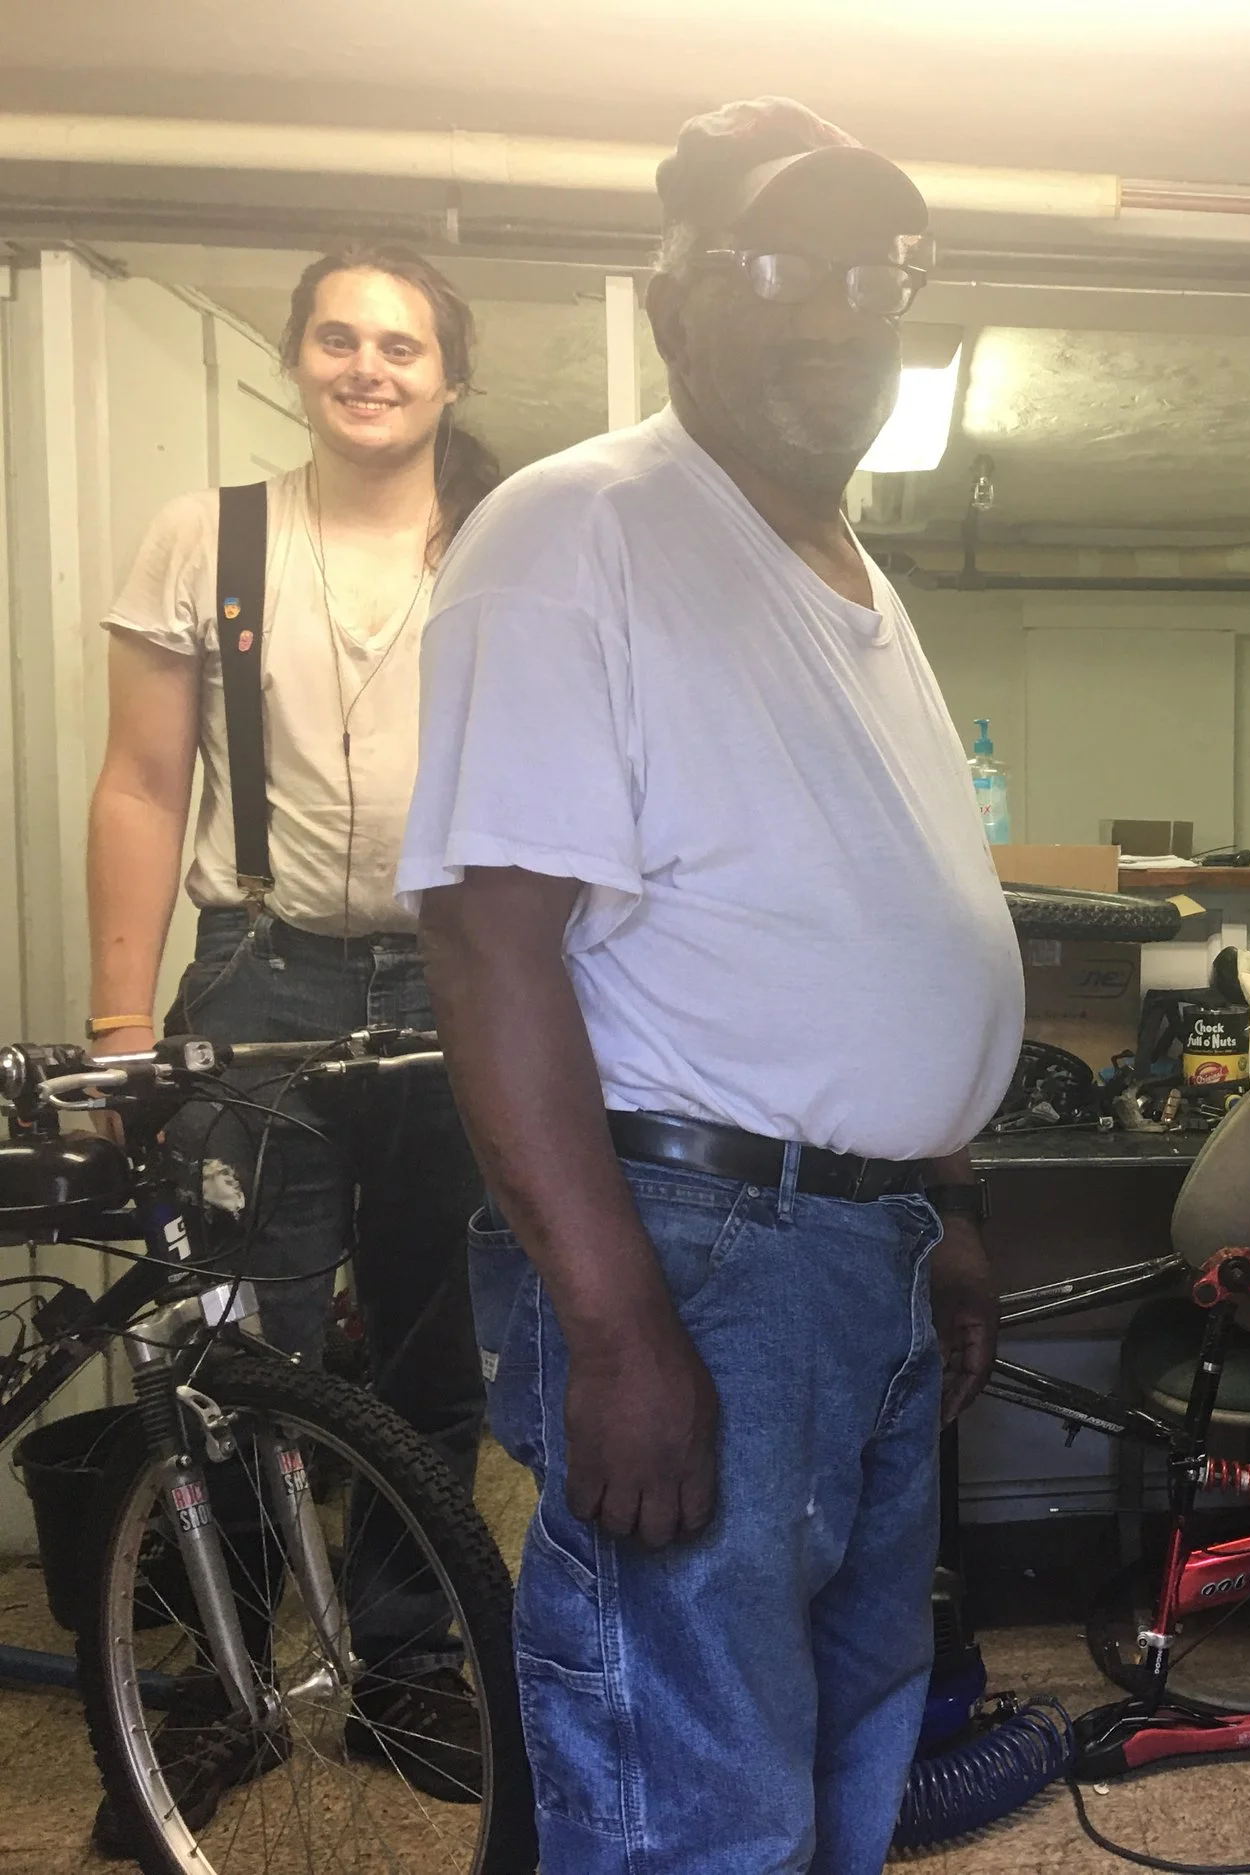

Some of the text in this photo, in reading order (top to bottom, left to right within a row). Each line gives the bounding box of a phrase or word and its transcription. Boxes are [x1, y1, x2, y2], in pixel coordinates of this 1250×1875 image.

[1194, 1019, 1225, 1036] Chock
[1186, 1034, 1203, 1048] full
[1212, 1034, 1237, 1049] Nuts
